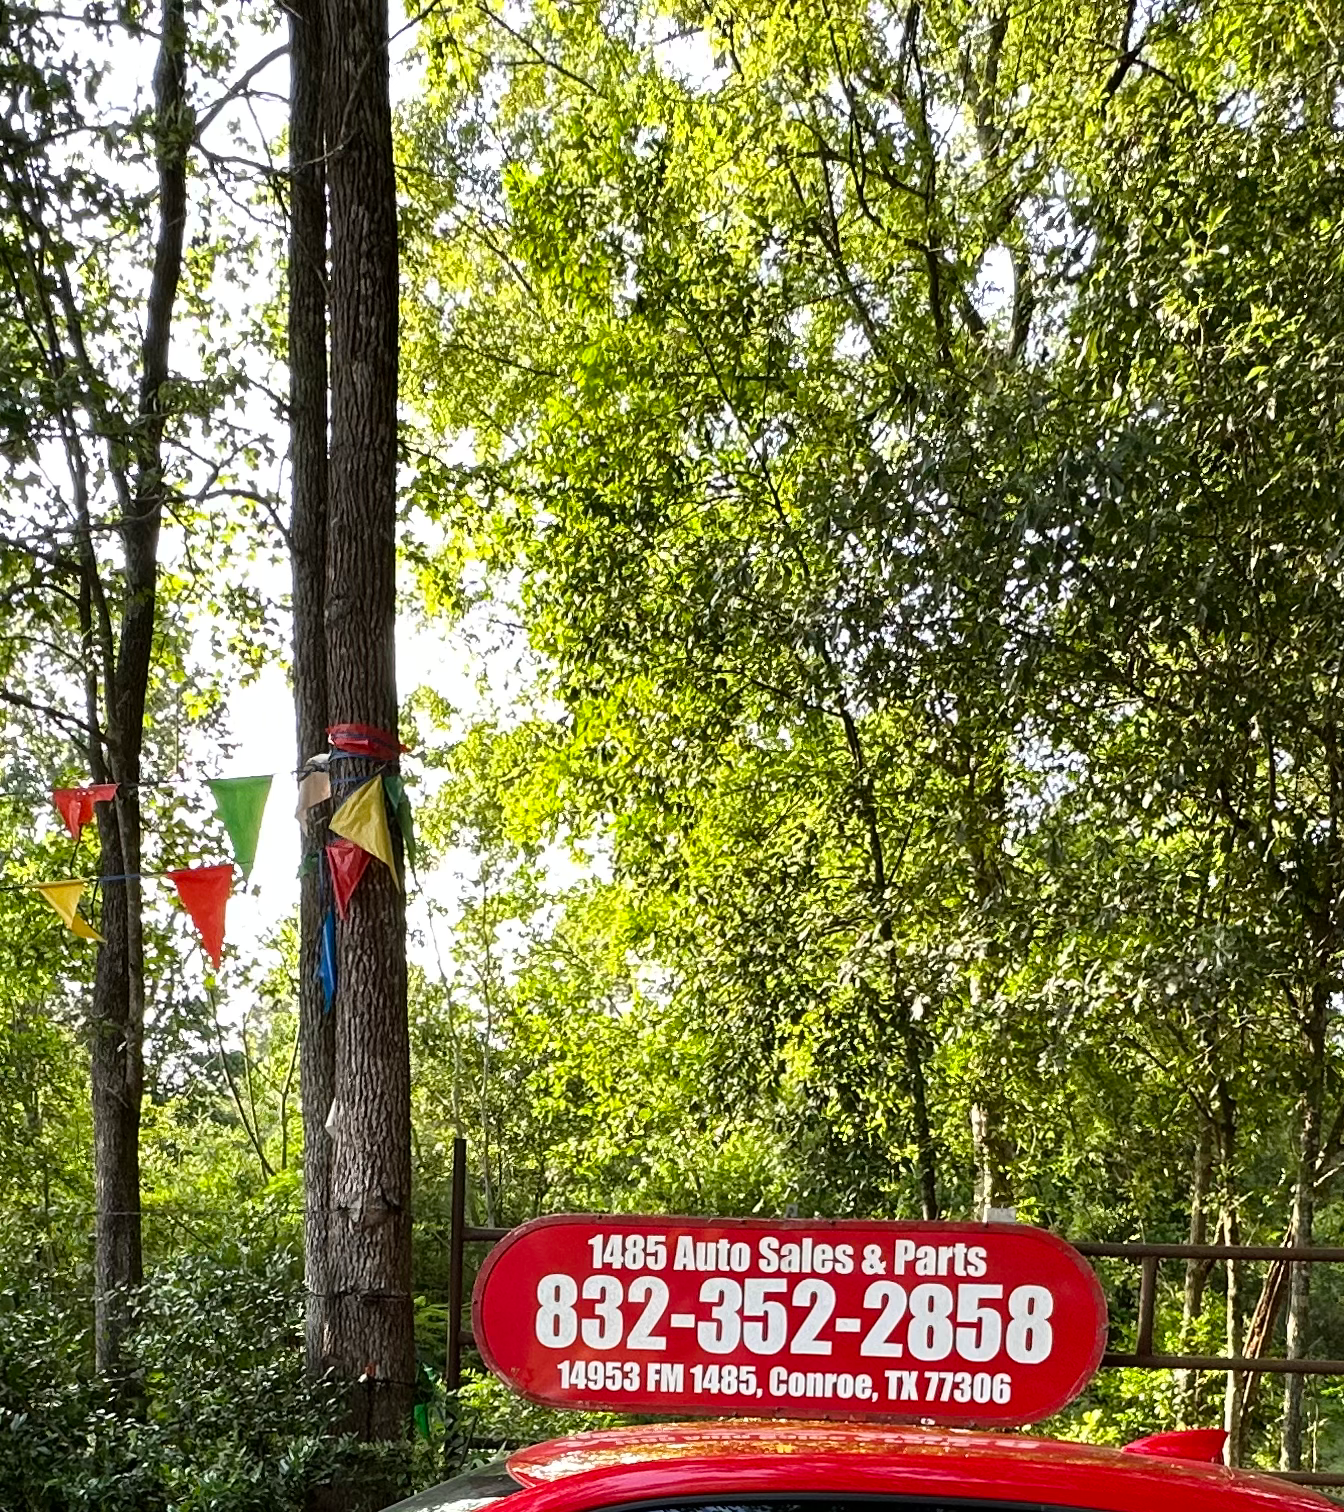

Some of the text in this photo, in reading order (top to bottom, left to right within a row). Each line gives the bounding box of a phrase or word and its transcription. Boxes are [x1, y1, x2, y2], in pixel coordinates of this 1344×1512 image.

[587, 1233, 988, 1278] 1485 Auto Sales & Parts
[536, 1273, 1054, 1365] 832-352-2858
[557, 1360, 1012, 1405] 14953 FM 1485, Conroe, TX 77306
